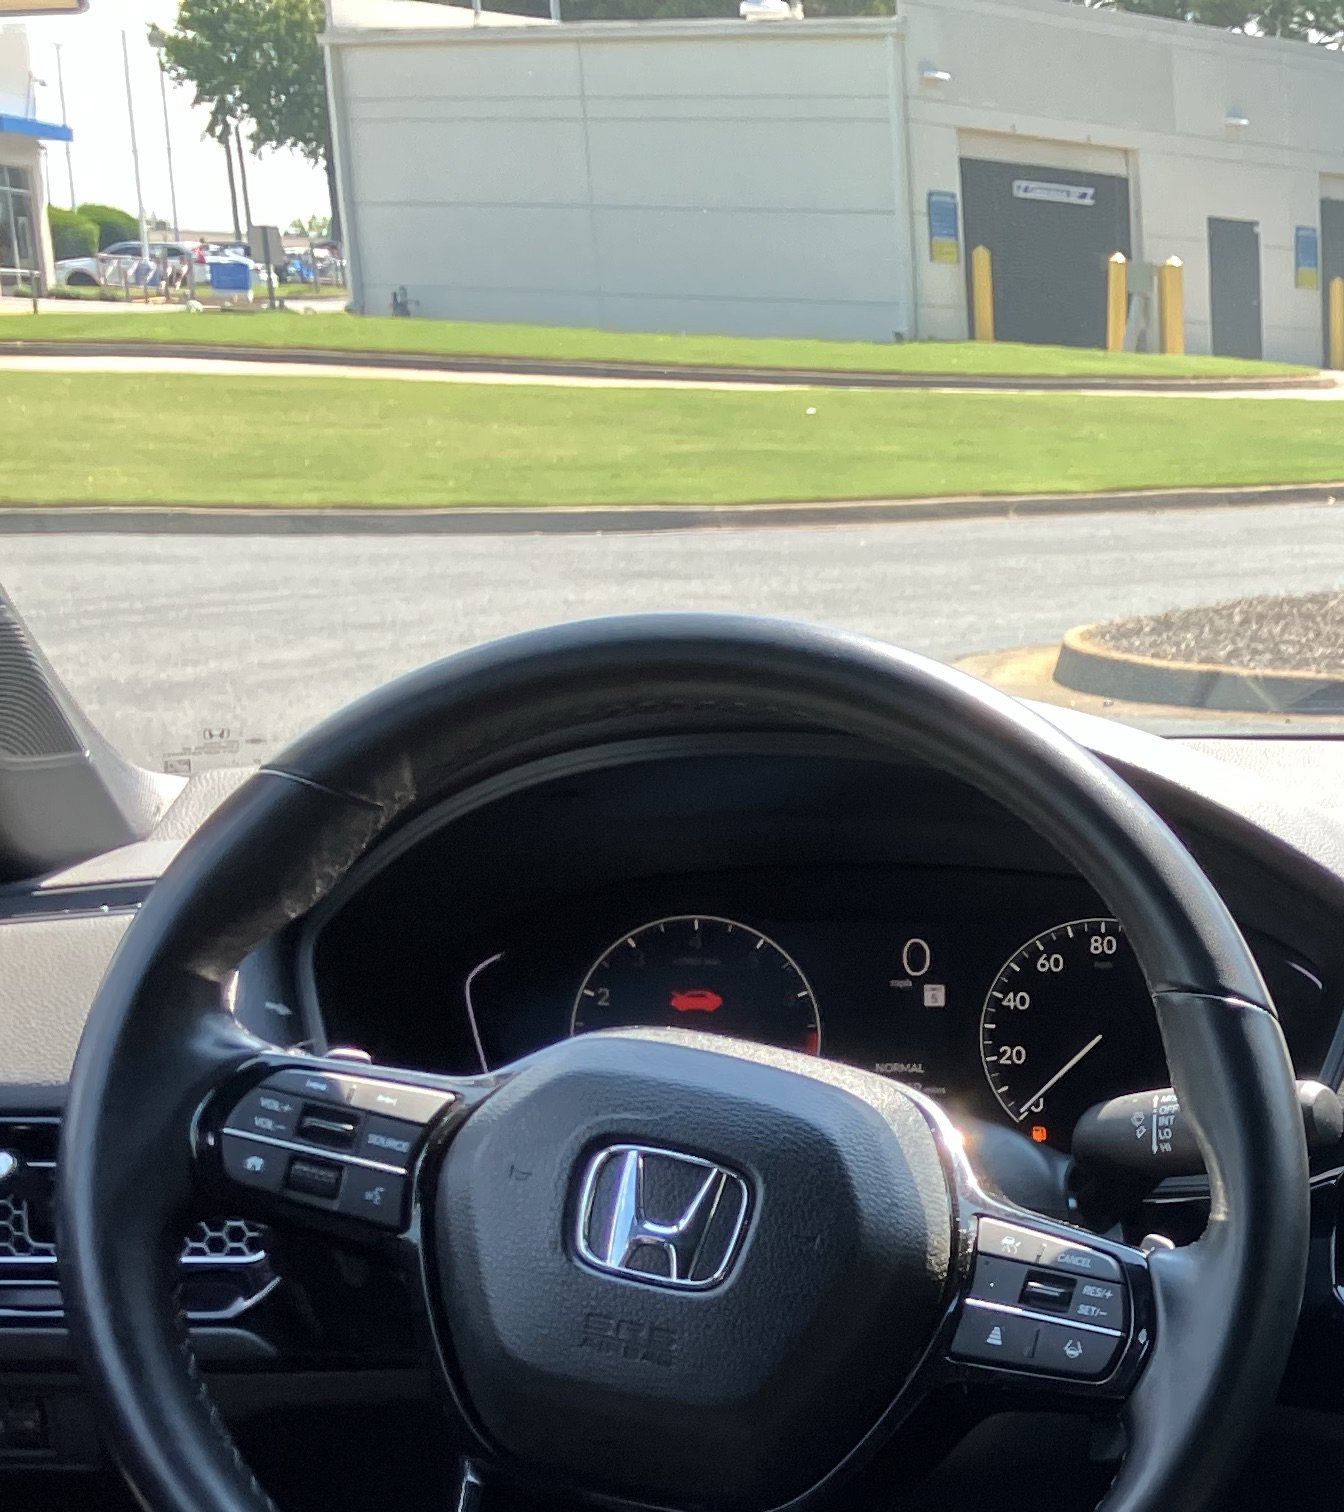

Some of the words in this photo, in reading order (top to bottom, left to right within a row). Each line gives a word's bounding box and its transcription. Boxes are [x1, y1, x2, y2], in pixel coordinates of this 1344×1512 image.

[1090, 936, 1117, 954] 80
[1036, 953, 1064, 972] 60
[597, 987, 610, 1006] 2
[1001, 992, 1030, 1010] 40
[999, 1046, 1026, 1064] 20
[1057, 1252, 1092, 1269] CANCEL
